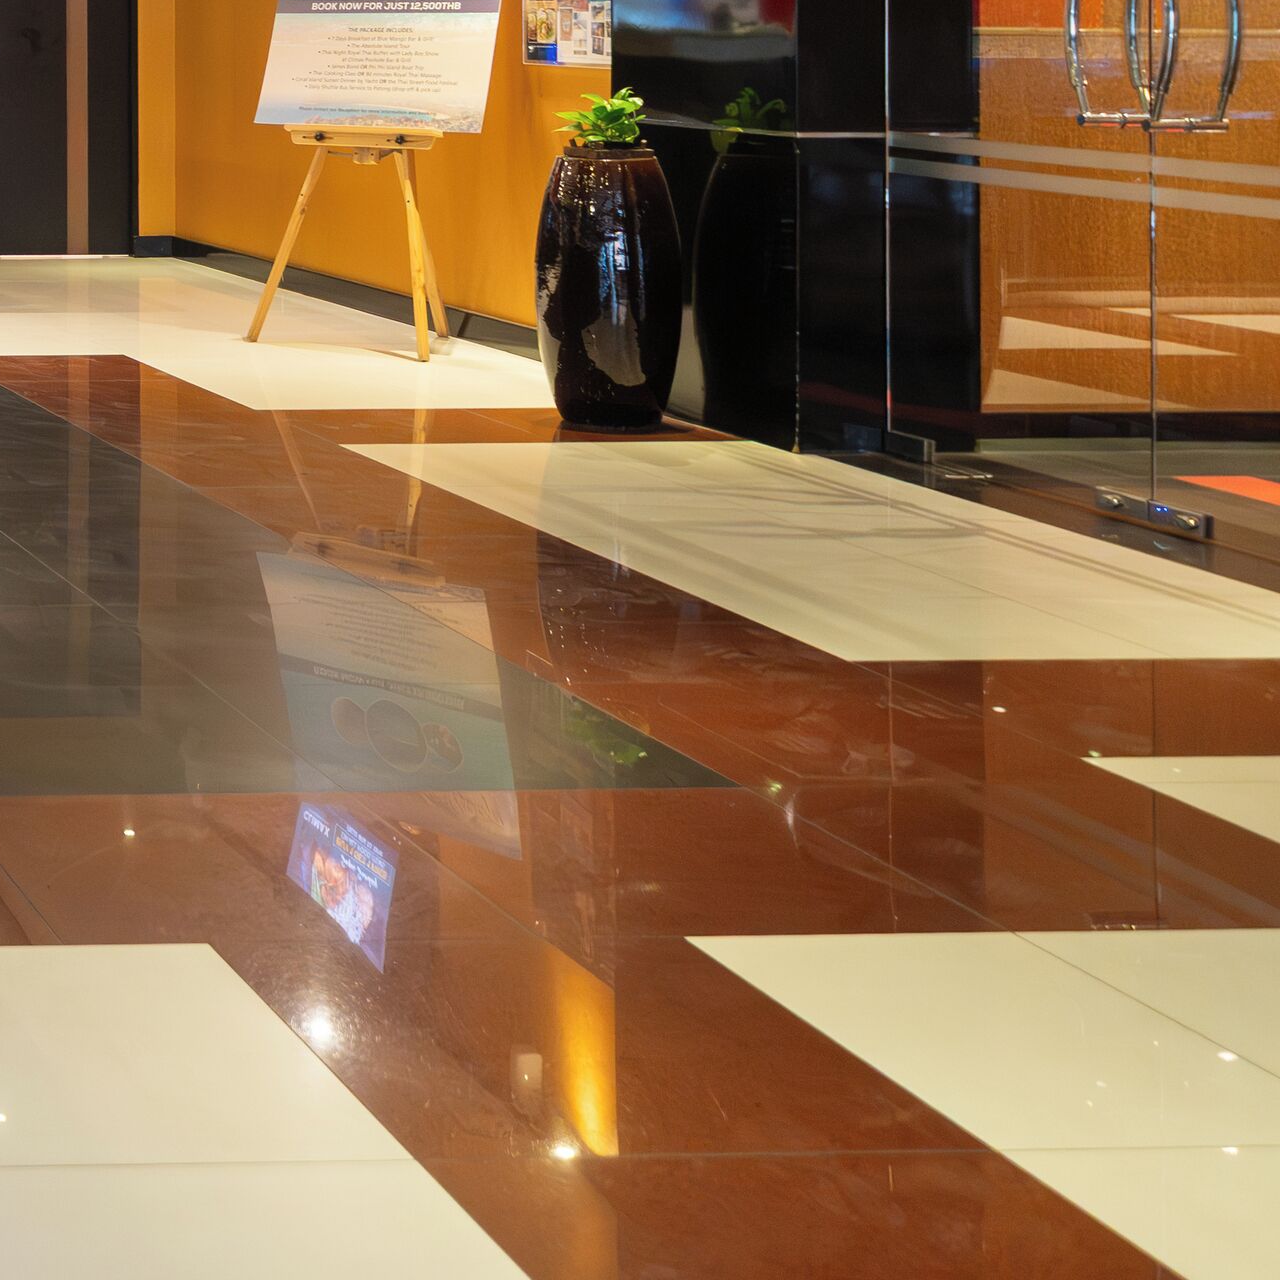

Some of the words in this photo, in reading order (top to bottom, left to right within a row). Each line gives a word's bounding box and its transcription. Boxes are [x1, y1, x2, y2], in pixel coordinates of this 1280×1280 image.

[311, 2, 338, 11] BOOK
[339, 2, 363, 11] NOW
[363, 2, 383, 10] FOR
[383, 2, 410, 10] JUST
